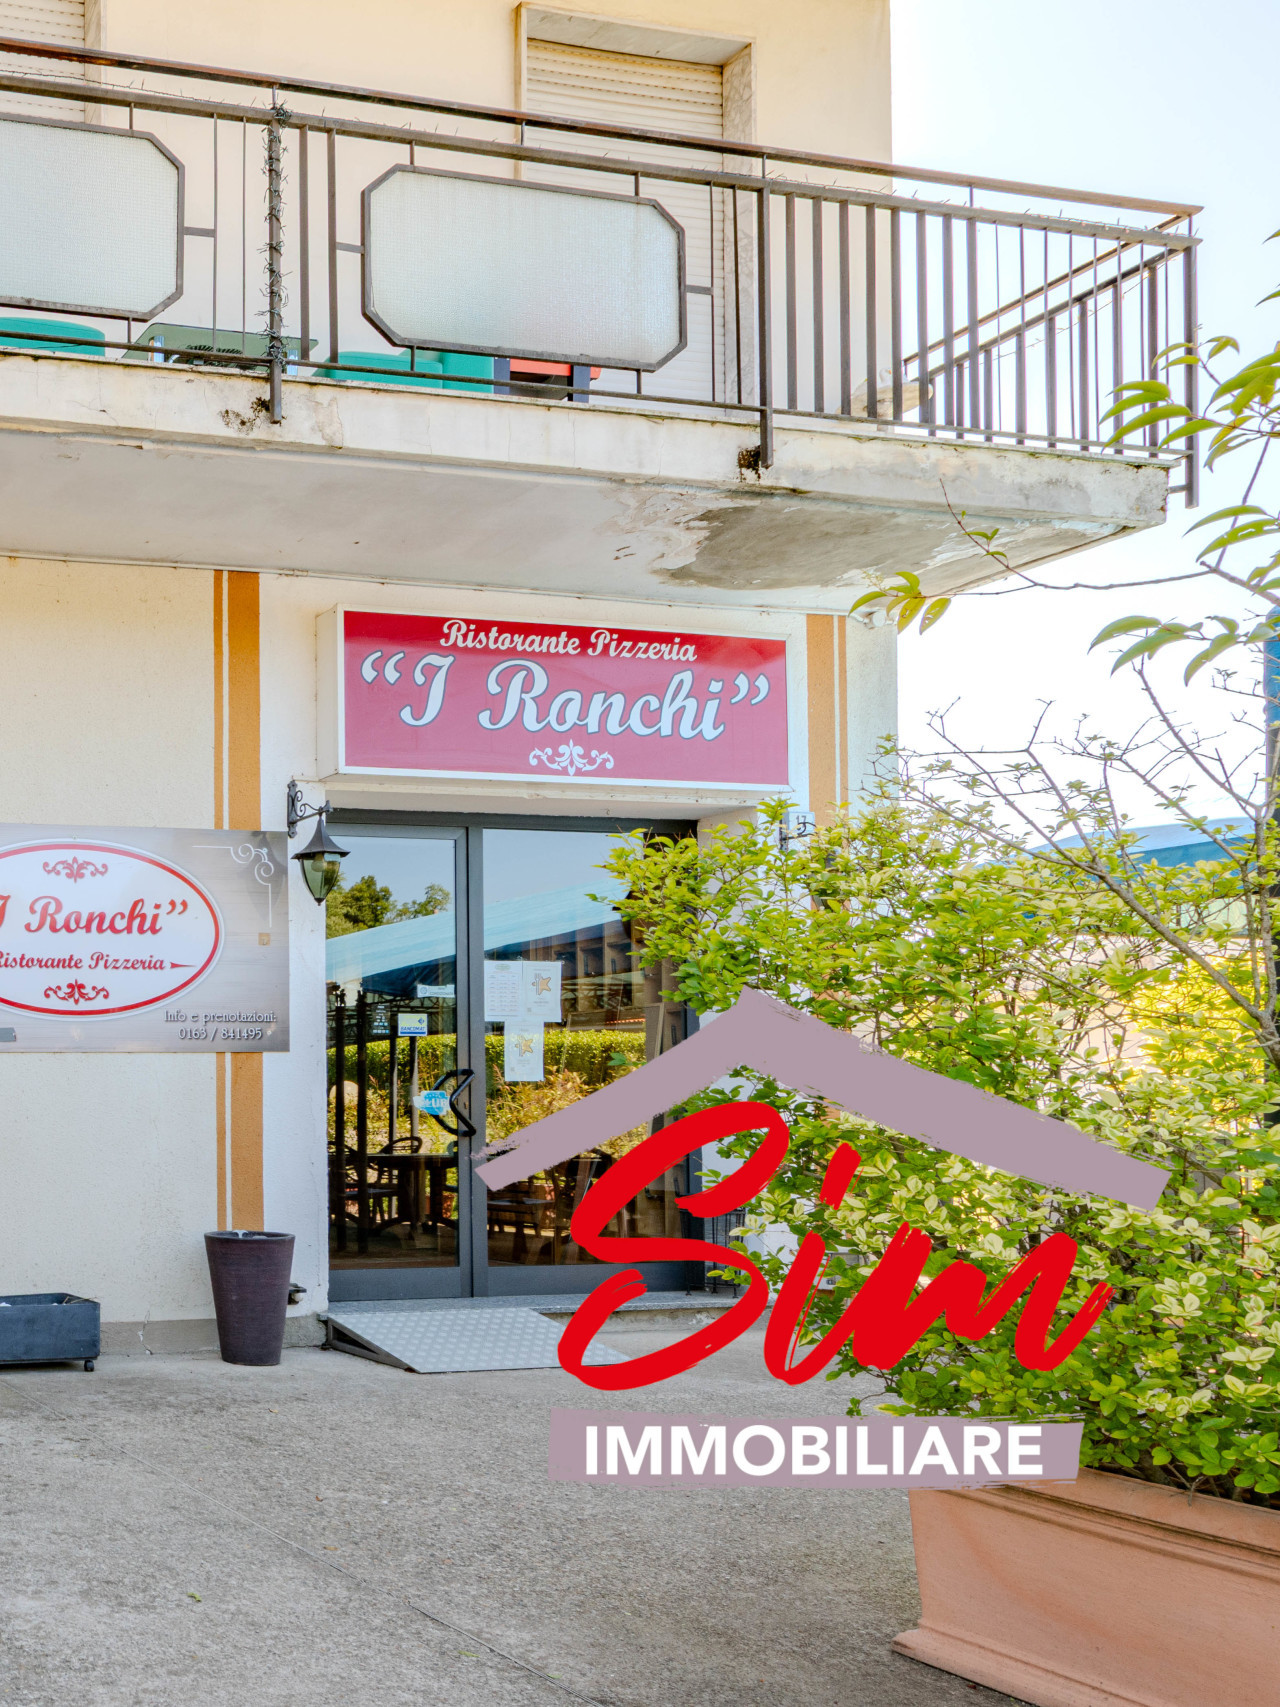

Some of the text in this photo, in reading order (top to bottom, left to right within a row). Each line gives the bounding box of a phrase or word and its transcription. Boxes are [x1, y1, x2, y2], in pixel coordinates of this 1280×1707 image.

[439, 619, 698, 662] Ristorante Pizzeria
[88, 951, 166, 970] Pizzeria
[164, 1010, 277, 1025] Info e prenotazioni:
[178, 1028, 207, 1040] 0163
[221, 1028, 263, 1040] 841495
